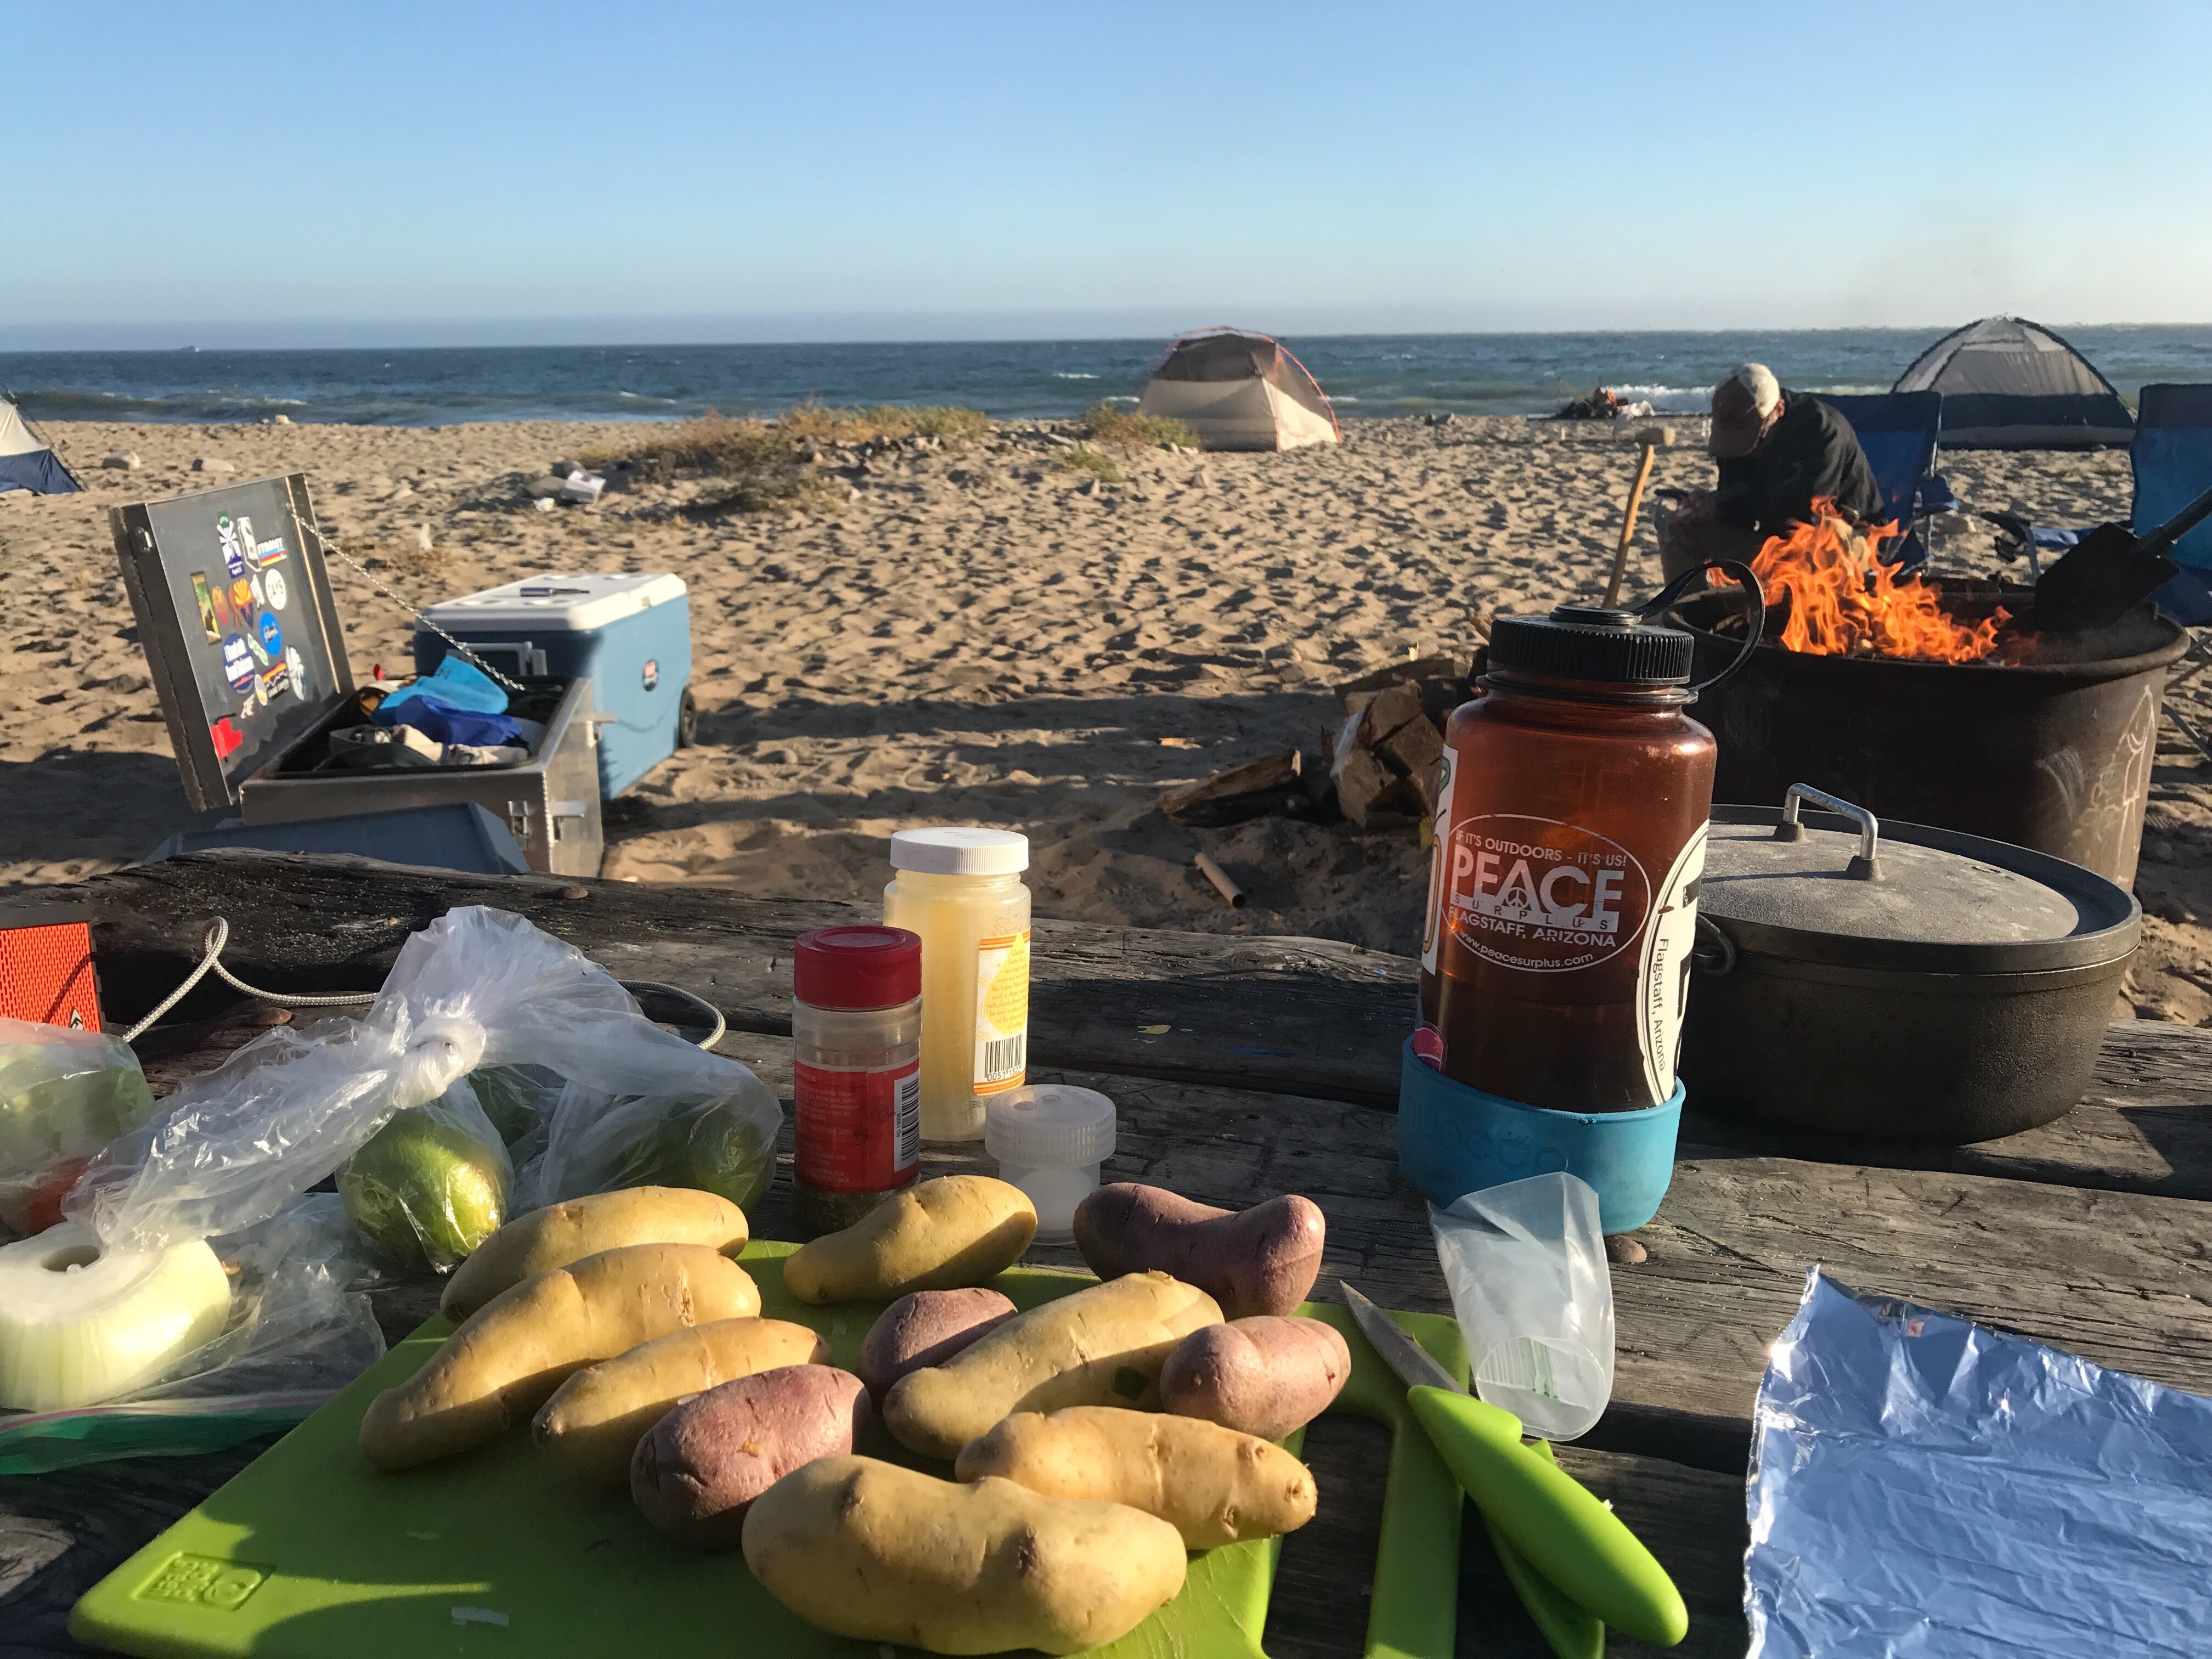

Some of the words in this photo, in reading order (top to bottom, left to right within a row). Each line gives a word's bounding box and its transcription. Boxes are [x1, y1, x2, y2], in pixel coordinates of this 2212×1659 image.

[1455, 830, 1464, 842] IF
[1465, 833, 1482, 847] IT'S
[1485, 838, 1562, 861] OUTDOORS
[1577, 851, 1601, 866] IT'S
[1605, 854, 1627, 867] US!
[1451, 844, 1624, 921] PEACE
[1448, 906, 1526, 940] FLAGSTAFF,
[1532, 927, 1616, 947] ARIZONA
[1455, 894, 1609, 930] SURPLUS
[1460, 929, 1594, 969] www.peacesurplus.com
[1650, 938, 1669, 1015] Flagstaff,
[1654, 1019, 1666, 1072] Arizona
[987, 1070, 1005, 1081] 0051
